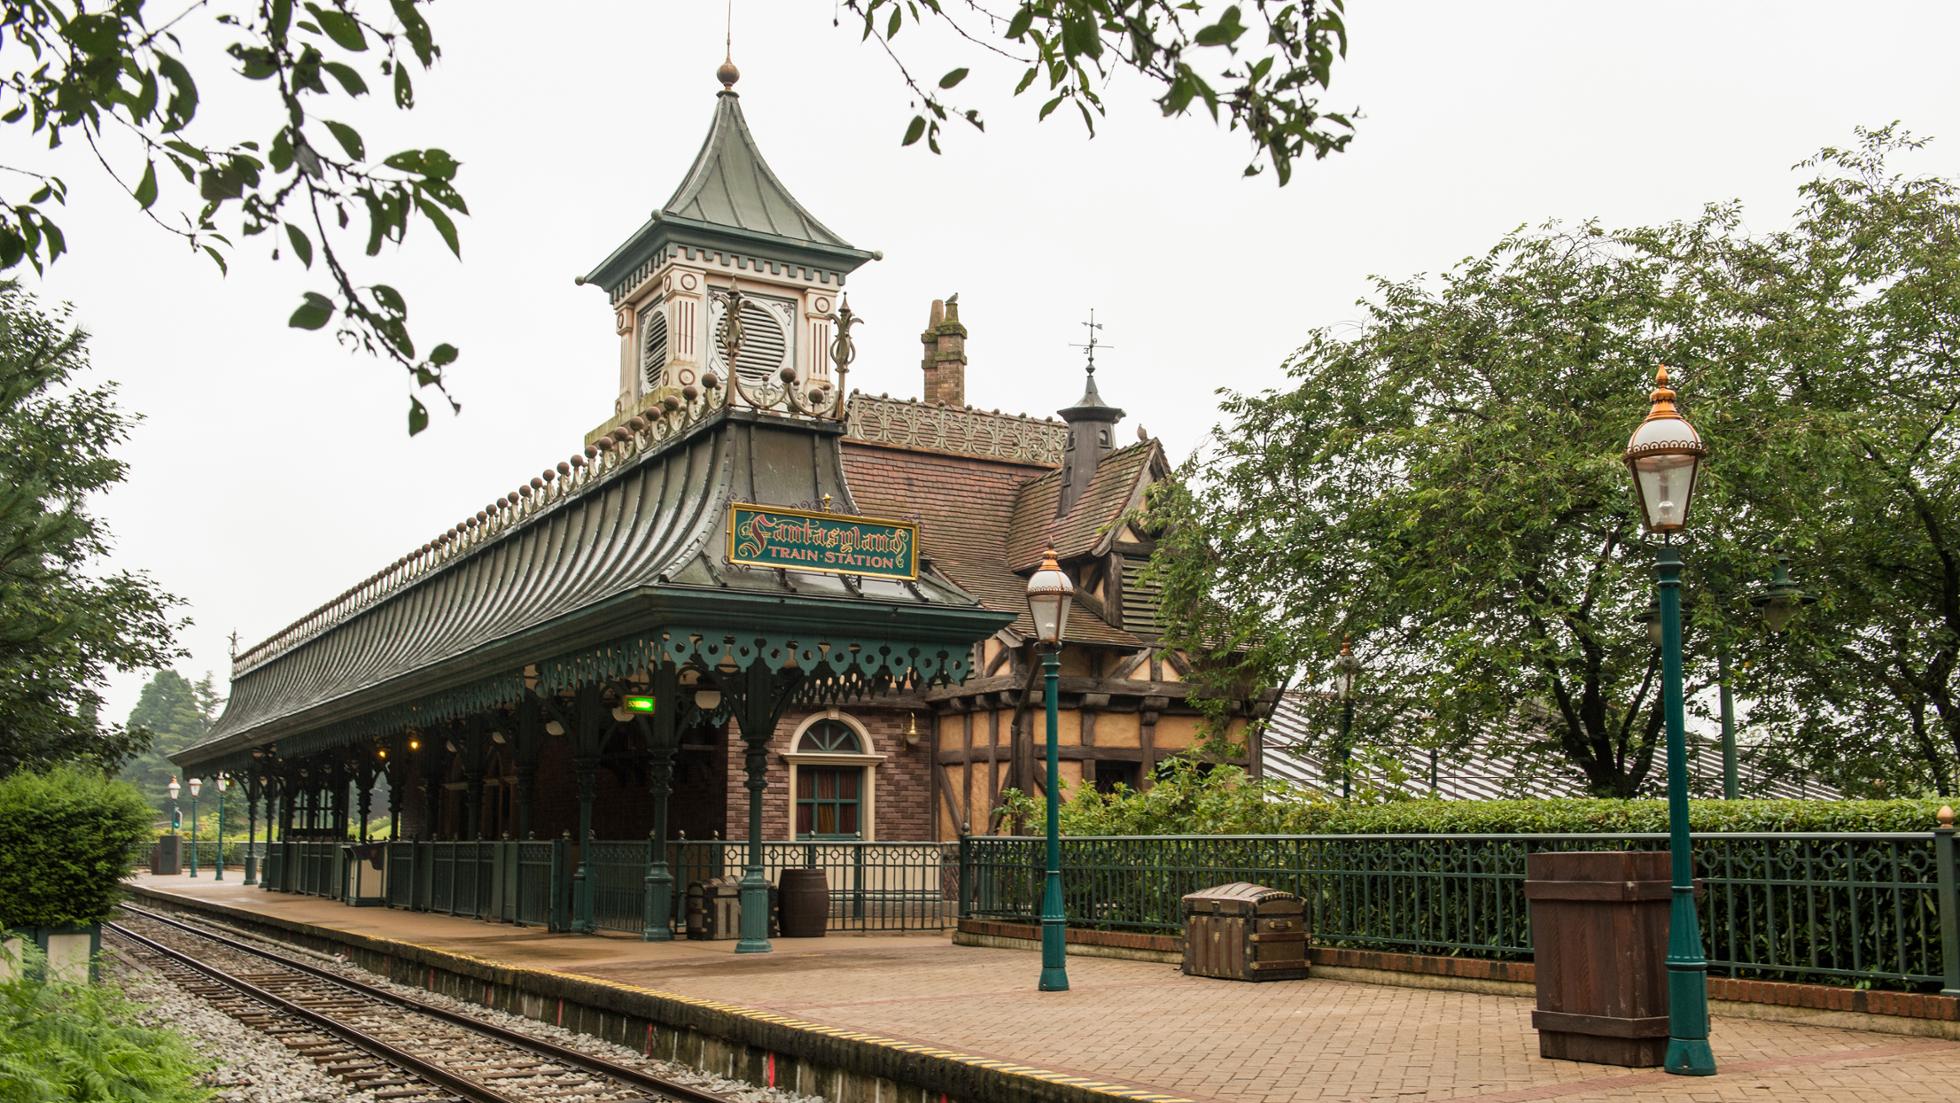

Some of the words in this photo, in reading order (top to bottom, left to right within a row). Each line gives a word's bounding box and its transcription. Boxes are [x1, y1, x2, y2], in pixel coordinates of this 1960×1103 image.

[738, 513, 909, 563] Fantasyland
[768, 545, 819, 562] TRAIN
[824, 551, 894, 569] STATION
